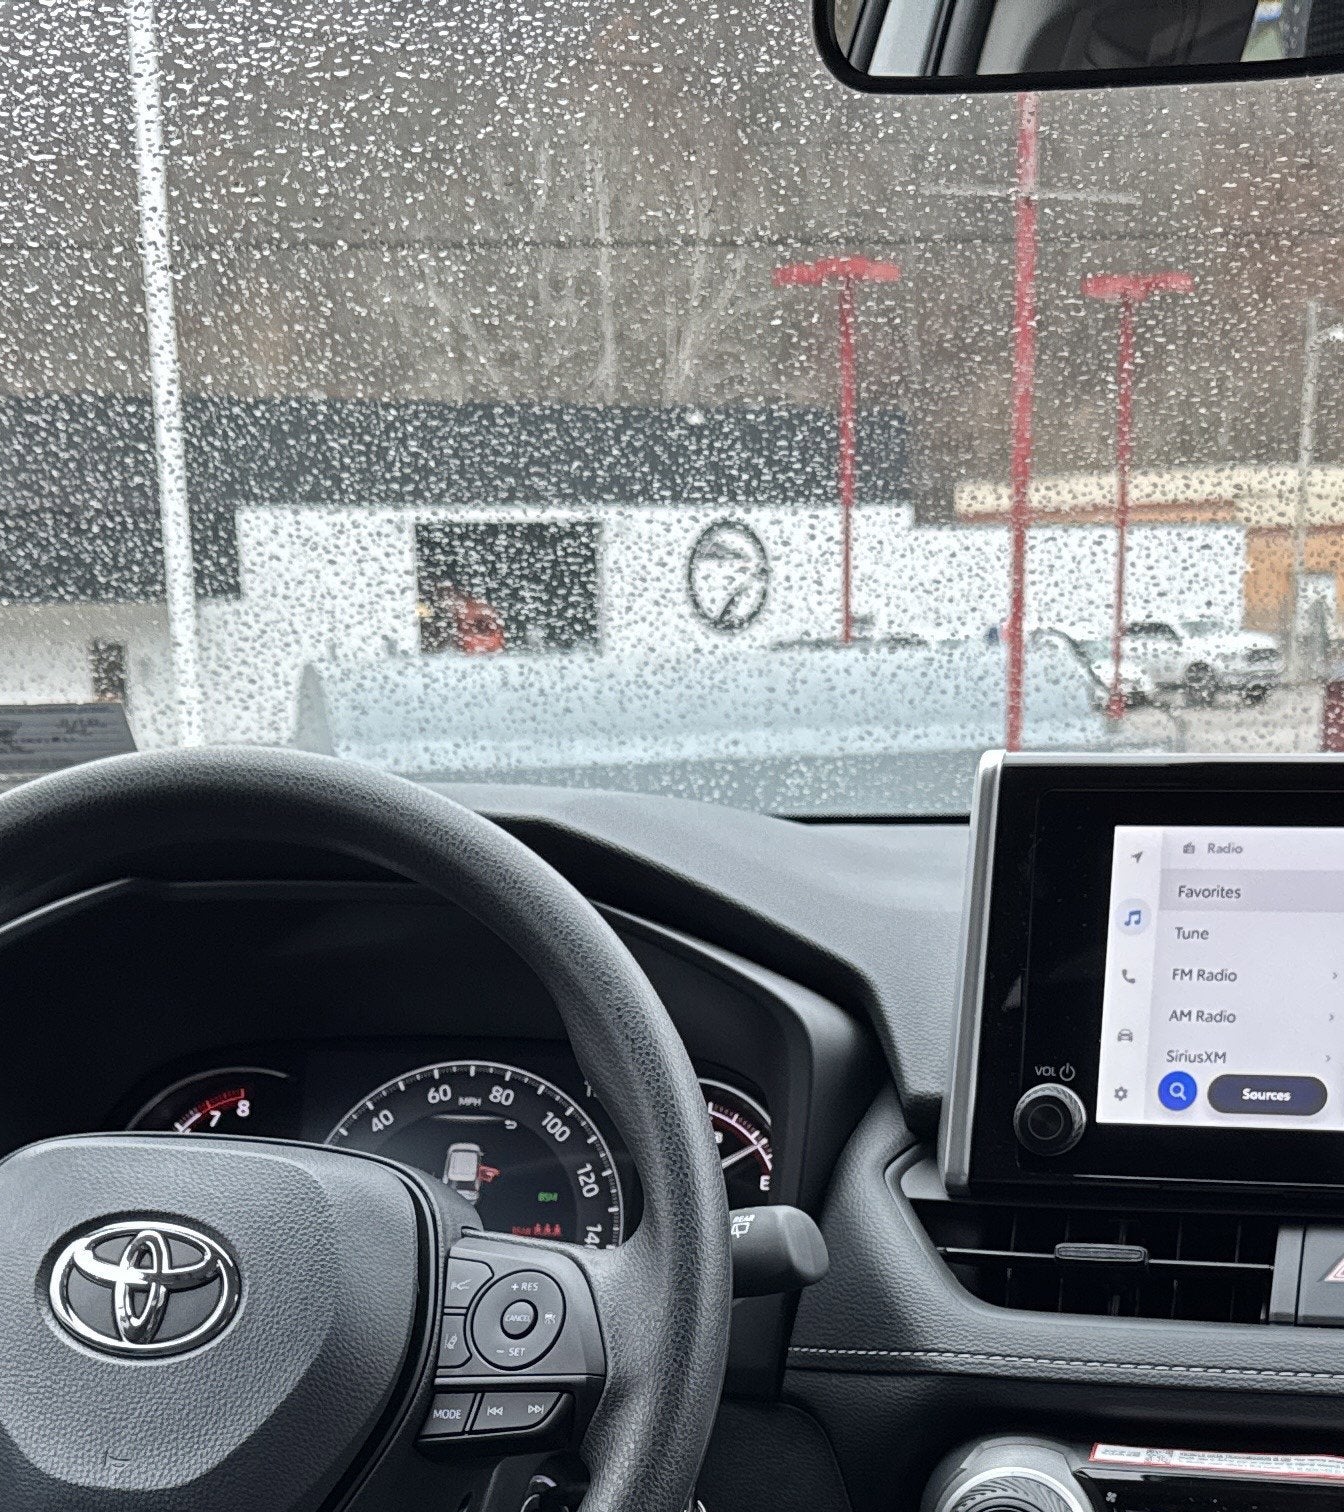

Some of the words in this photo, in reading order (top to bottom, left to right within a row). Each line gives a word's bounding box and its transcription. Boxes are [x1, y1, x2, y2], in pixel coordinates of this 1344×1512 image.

[1207, 842, 1243, 855] Radio
[1177, 884, 1242, 900] Favorites
[1175, 926, 1210, 941] Tune
[1172, 968, 1193, 981] FM
[1197, 968, 1238, 982] Radio
[1168, 1009, 1192, 1023] AM
[1196, 1010, 1237, 1024] Radio
[1166, 1049, 1227, 1064] SiriusXM
[1034, 1065, 1056, 1077] VOL
[427, 1084, 452, 1104] 60
[458, 1096, 482, 1107] MPH
[488, 1085, 514, 1106] 80
[1241, 1087, 1292, 1102] Sources
[236, 1099, 250, 1117] 8
[209, 1109, 222, 1128] 7
[370, 1109, 394, 1132] 40
[540, 1111, 571, 1142] 100
[576, 1162, 600, 1198] 120
[759, 1174, 771, 1191] E
[732, 1214, 755, 1223] REAR
[520, 1281, 539, 1291] RES
[508, 1347, 526, 1357] SET
[432, 1409, 462, 1420] MODE
